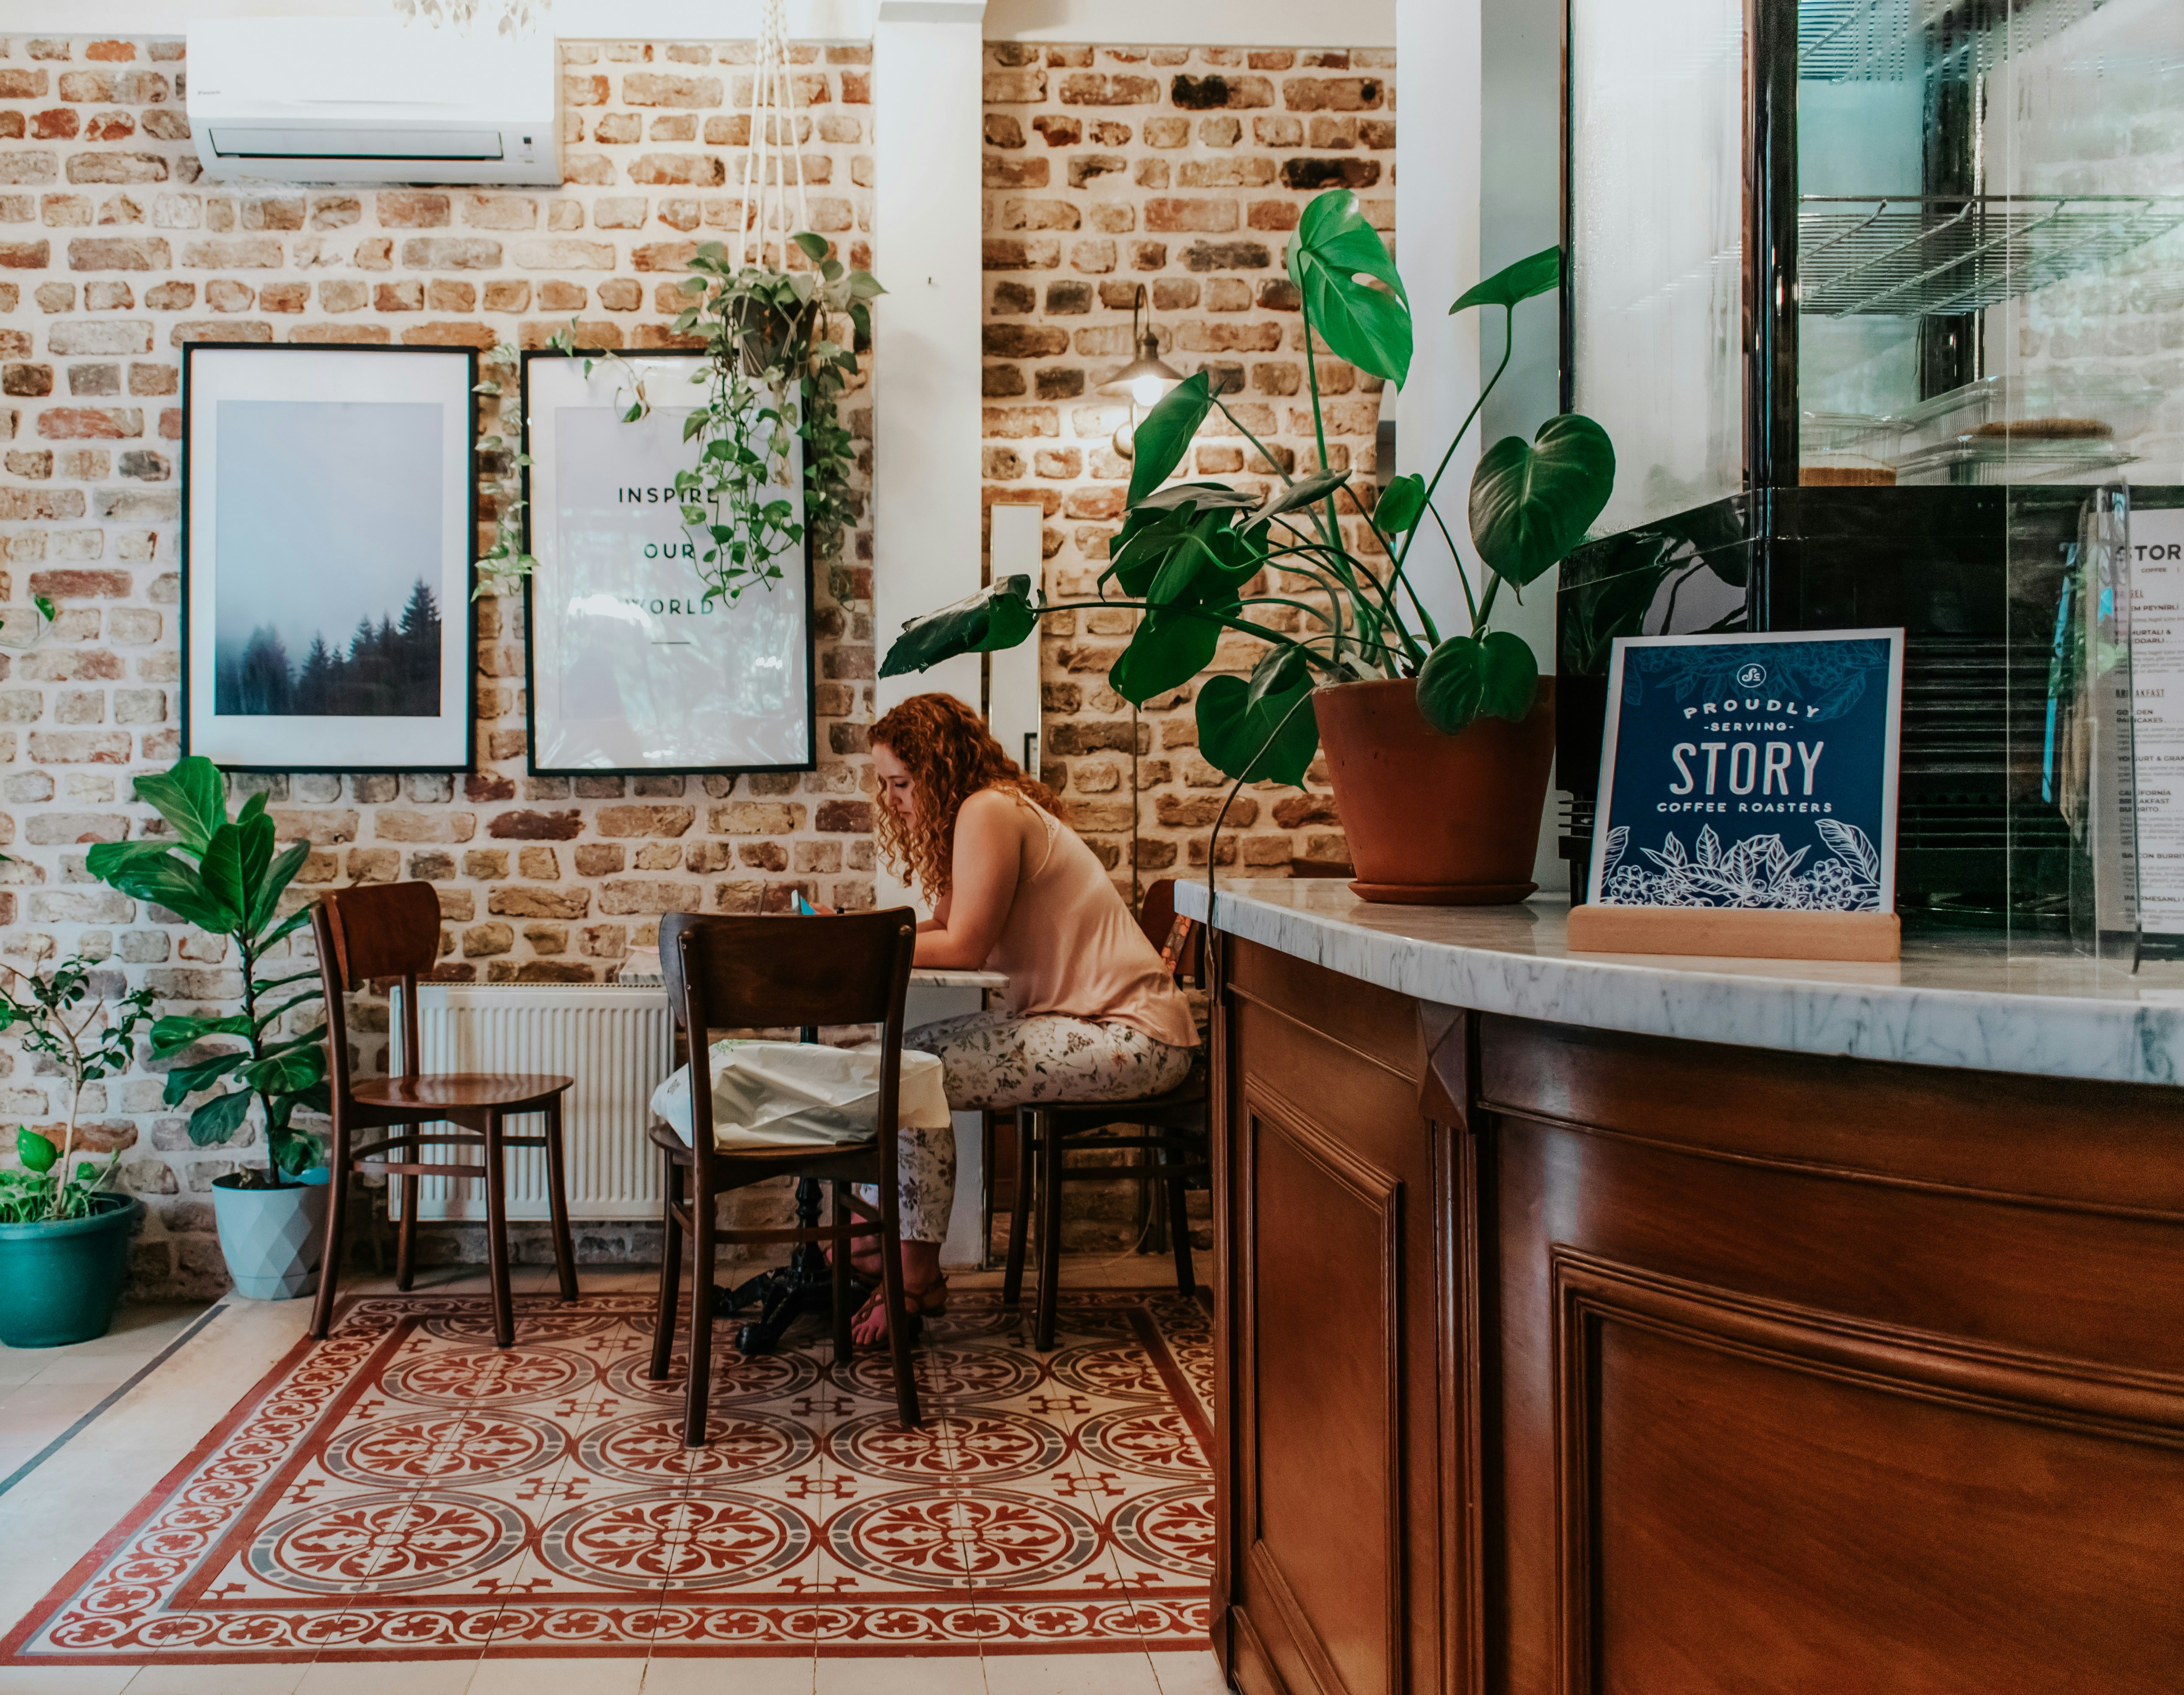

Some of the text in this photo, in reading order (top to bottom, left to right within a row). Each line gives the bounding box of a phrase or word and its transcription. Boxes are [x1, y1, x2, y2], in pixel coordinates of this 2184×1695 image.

[644, 543, 696, 559] OUR
[2115, 544, 2184, 562] STOR
[2115, 689, 2165, 697] BRAKFAST
[1683, 698, 1820, 720] PROUDLY
[1669, 741, 1825, 796] STORY
[1657, 802, 1832, 813] COFFEE ROASTERS
